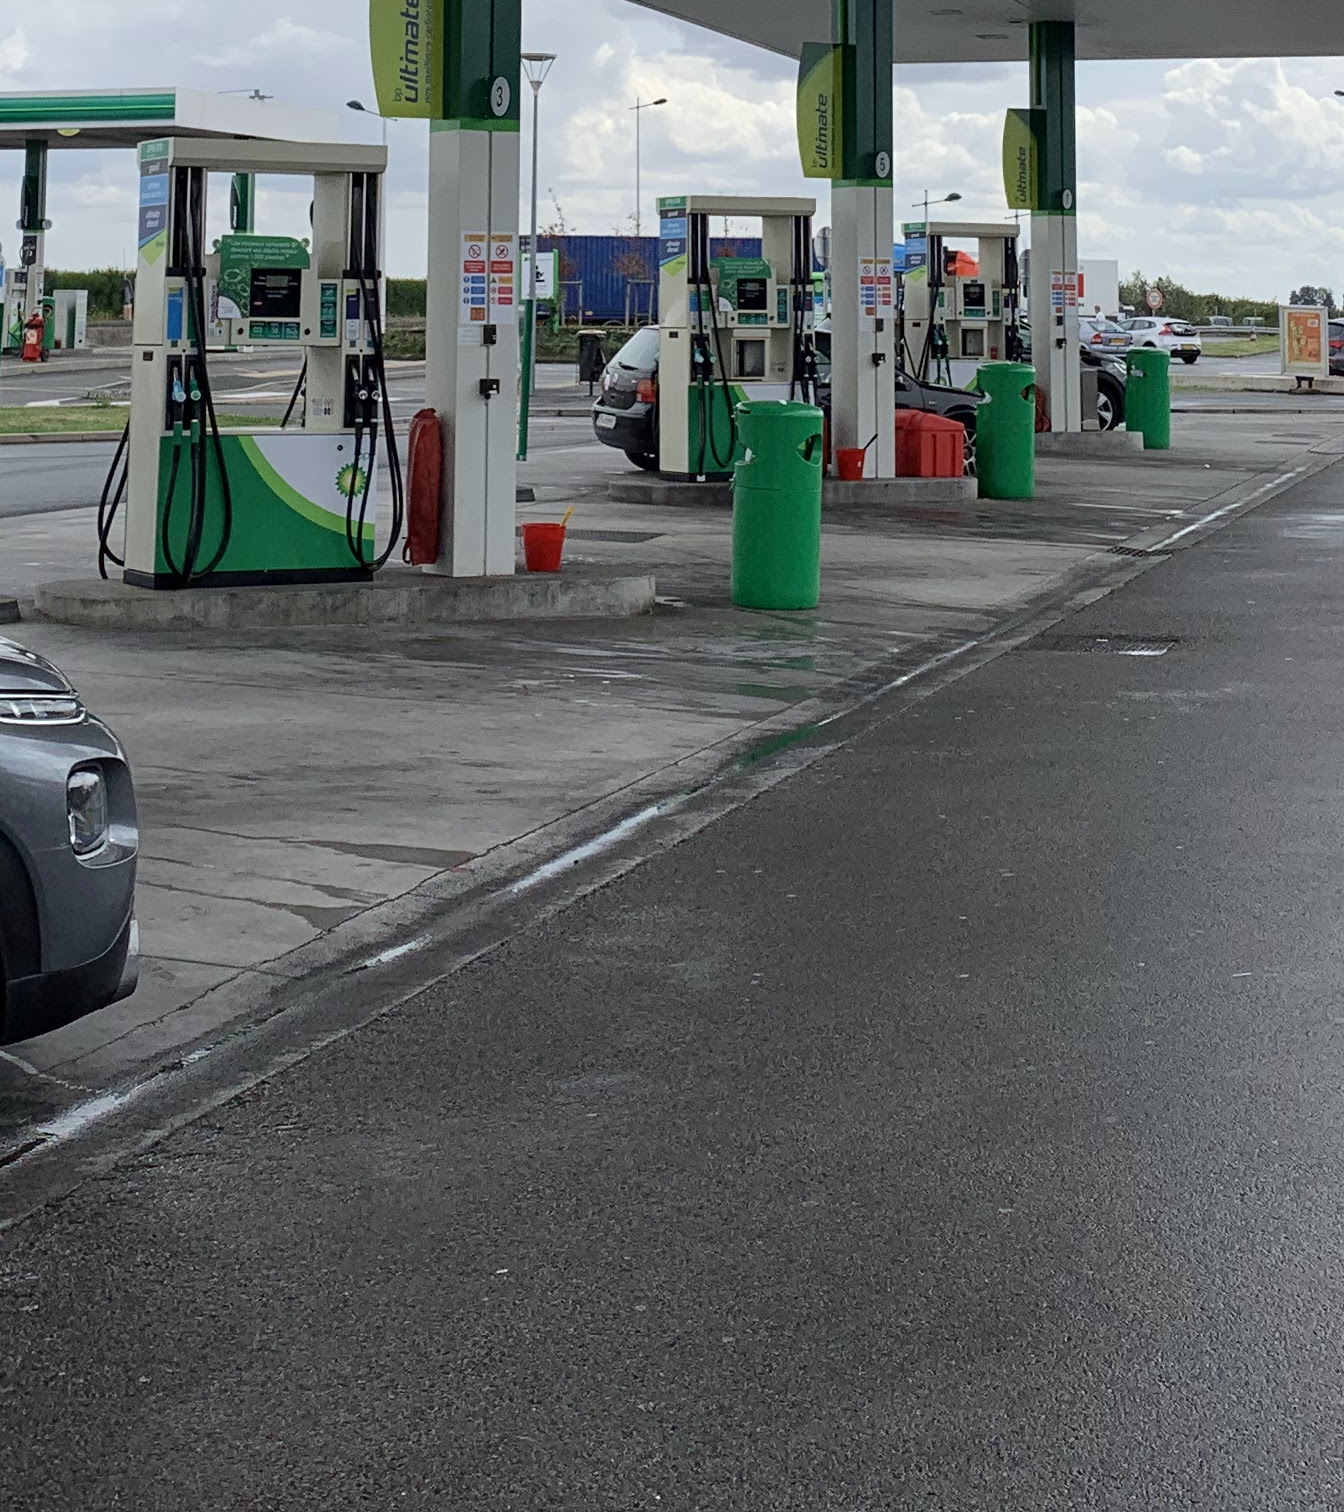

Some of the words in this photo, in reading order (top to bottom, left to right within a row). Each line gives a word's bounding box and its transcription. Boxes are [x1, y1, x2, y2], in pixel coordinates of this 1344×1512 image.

[497, 86, 503, 107] 3
[815, 93, 828, 169] ultimate
[879, 157, 886, 172] 5
